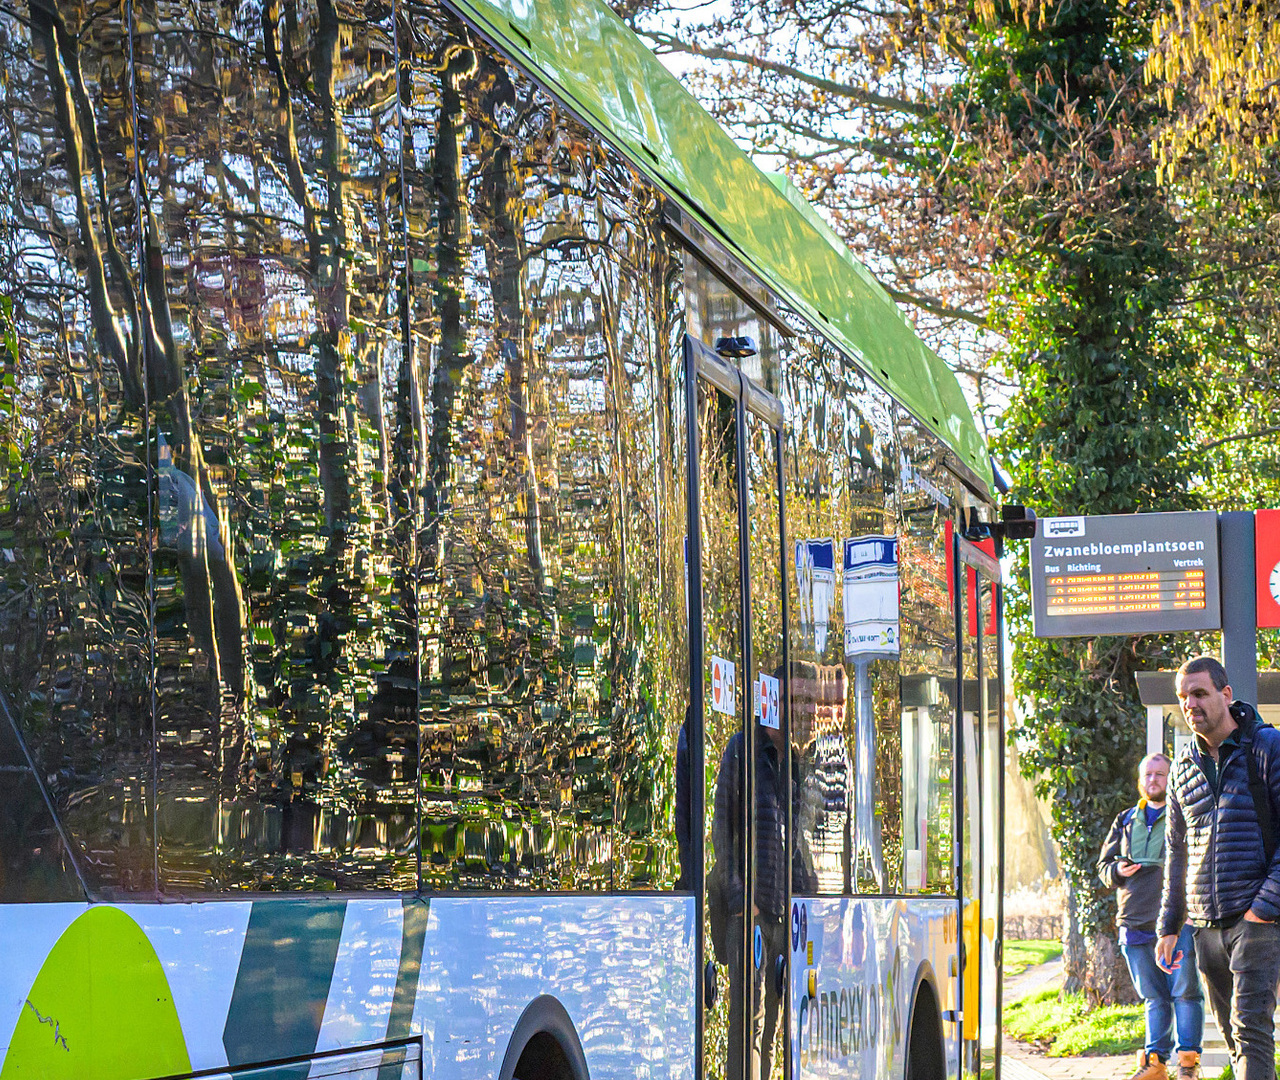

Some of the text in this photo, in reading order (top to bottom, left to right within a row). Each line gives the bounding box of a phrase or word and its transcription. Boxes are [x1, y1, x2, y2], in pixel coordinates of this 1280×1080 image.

[1043, 540, 1205, 557] Zwanebloemplantsoen
[1045, 557, 1204, 573] Bus Richting Vertrek
